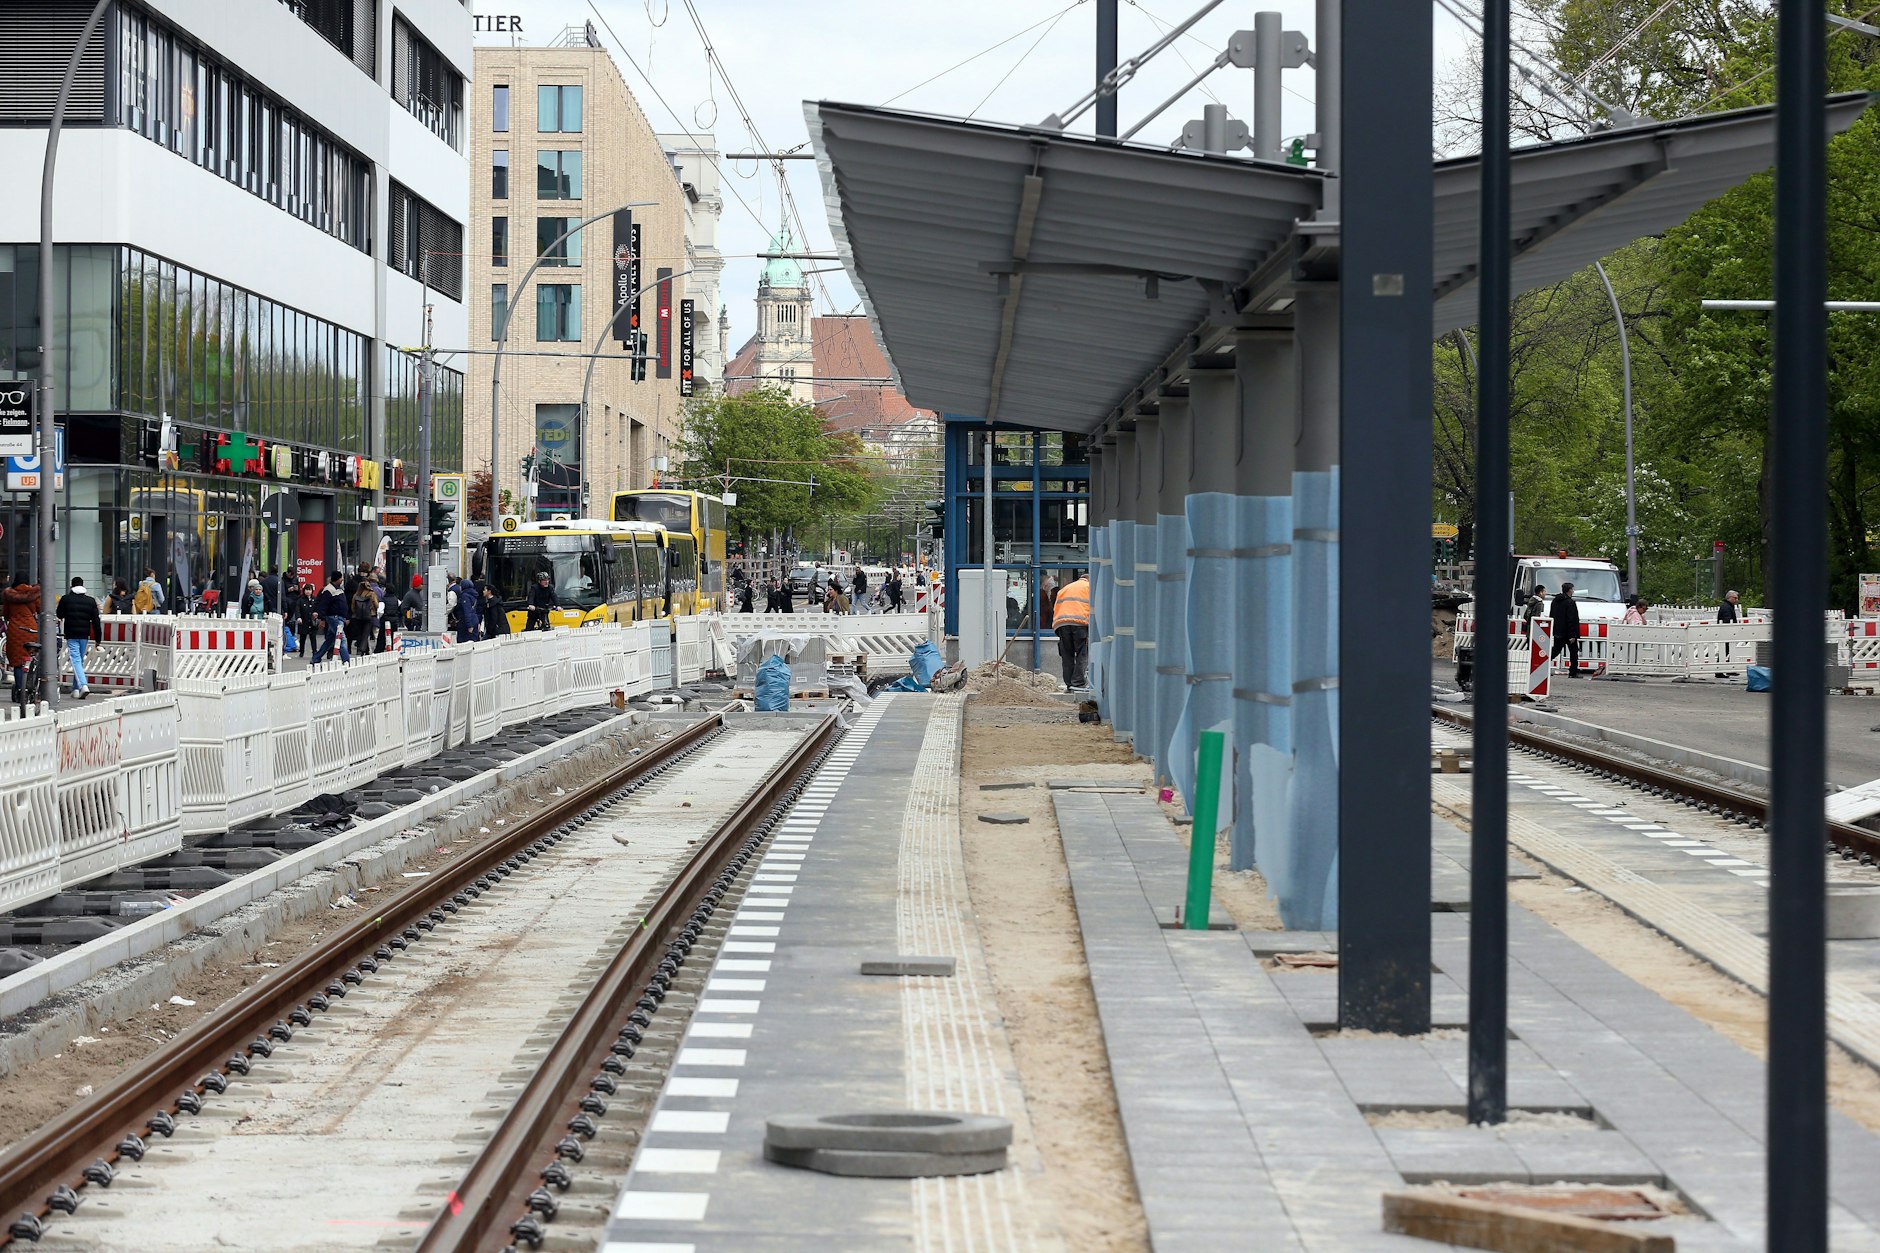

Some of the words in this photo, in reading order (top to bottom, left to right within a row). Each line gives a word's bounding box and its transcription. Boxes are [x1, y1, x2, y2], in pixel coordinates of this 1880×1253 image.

[473, 15, 523, 32] TIER
[618, 273, 629, 306] Apollo
[684, 303, 691, 314] US
[684, 316, 691, 328] OF
[7, 409, 27, 417] zeigen.
[22, 477, 35, 485] U9
[297, 558, 323, 566] Großer
[297, 567, 312, 575] Sale
